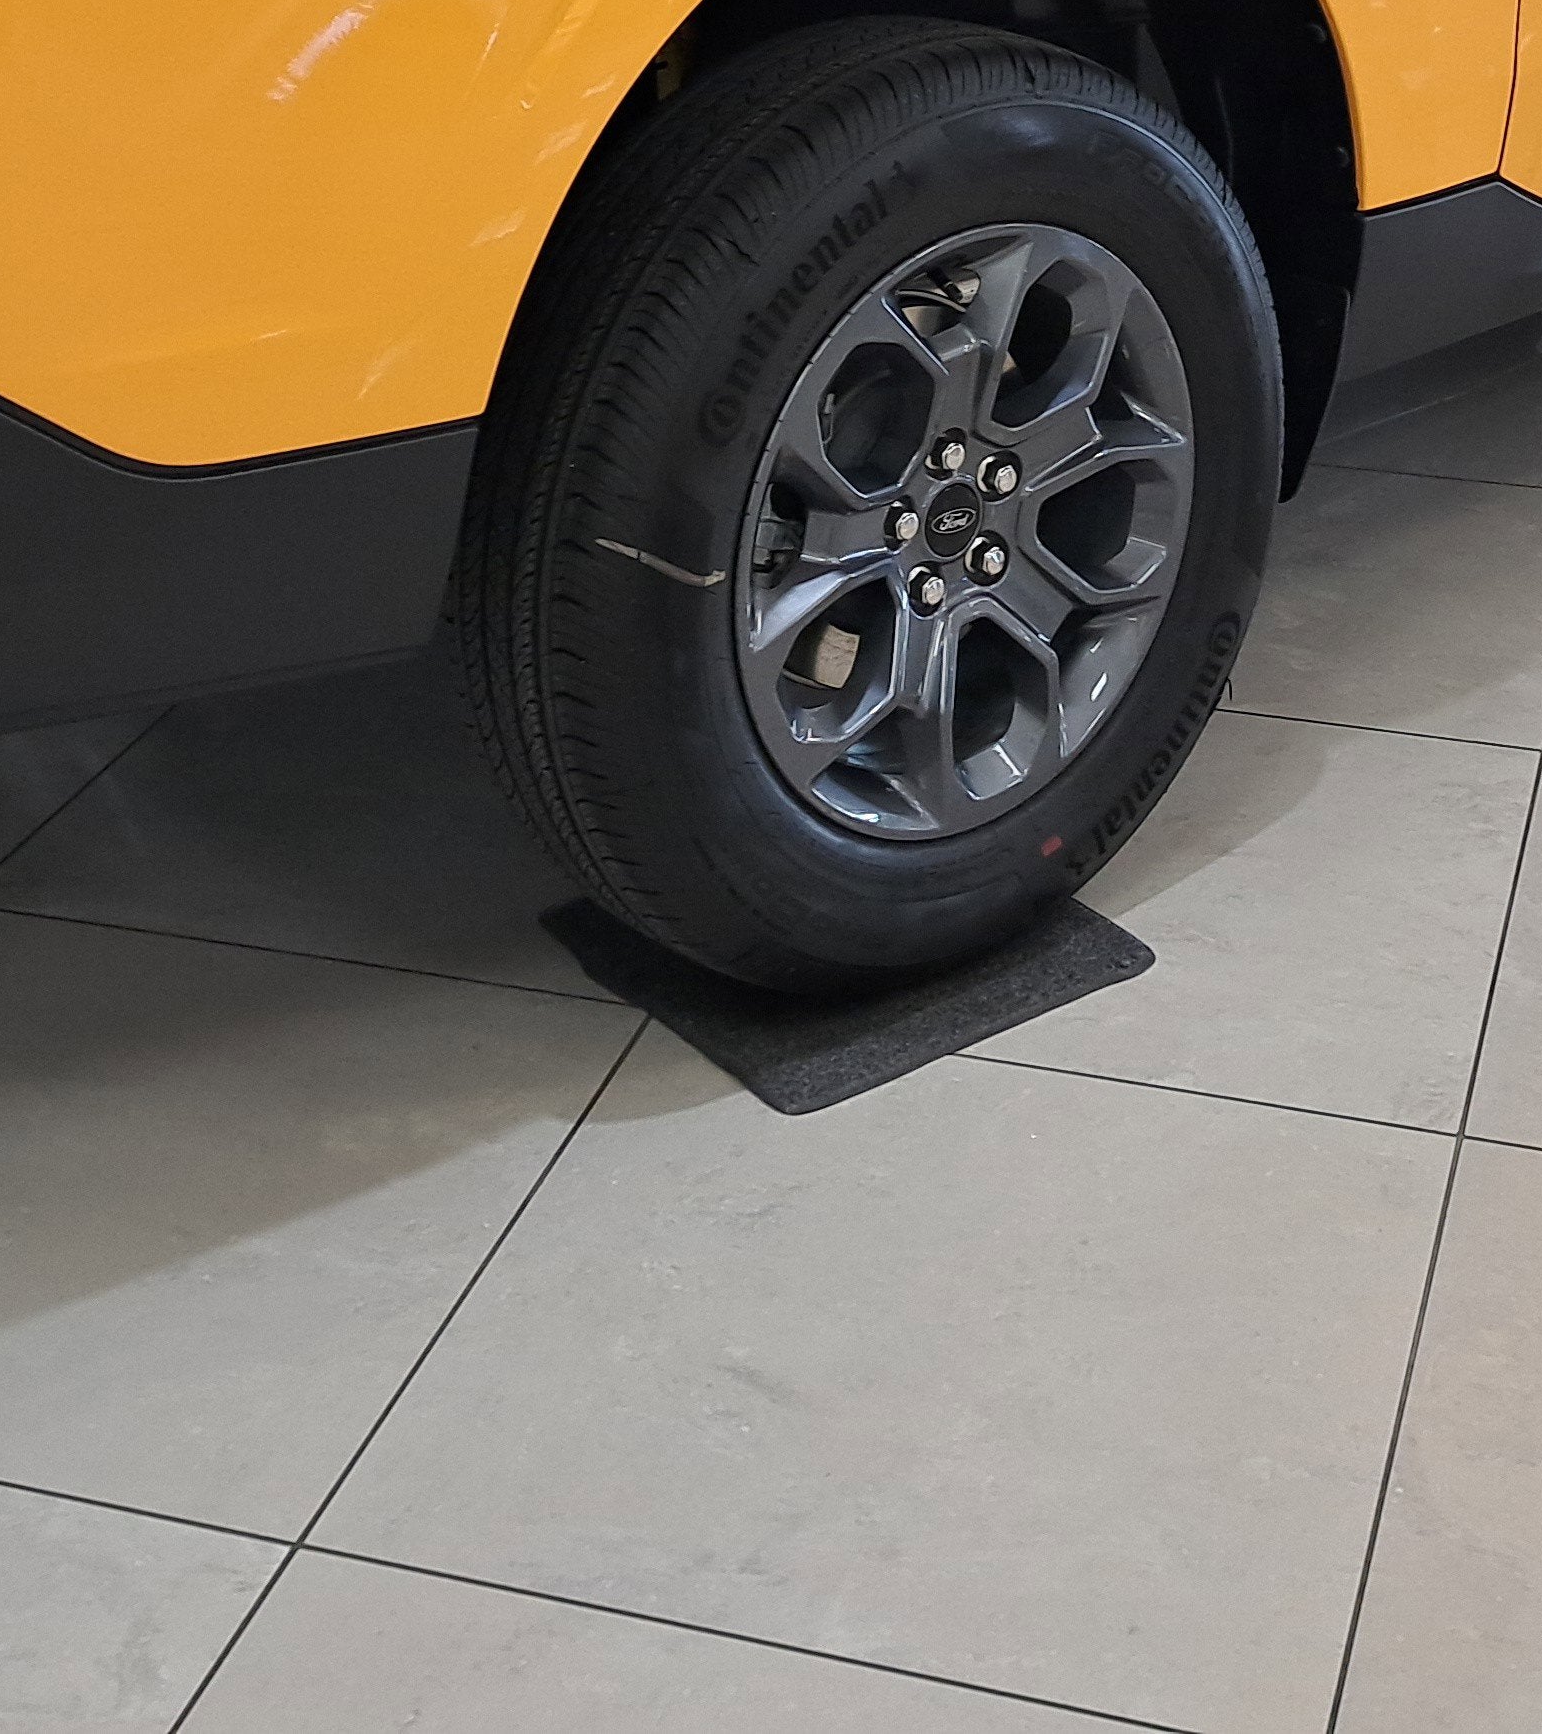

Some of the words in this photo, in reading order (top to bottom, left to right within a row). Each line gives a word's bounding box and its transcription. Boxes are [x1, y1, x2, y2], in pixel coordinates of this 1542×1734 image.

[698, 178, 888, 448] Continental
[939, 512, 970, 531] Ford
[1090, 610, 1242, 855] Continental
